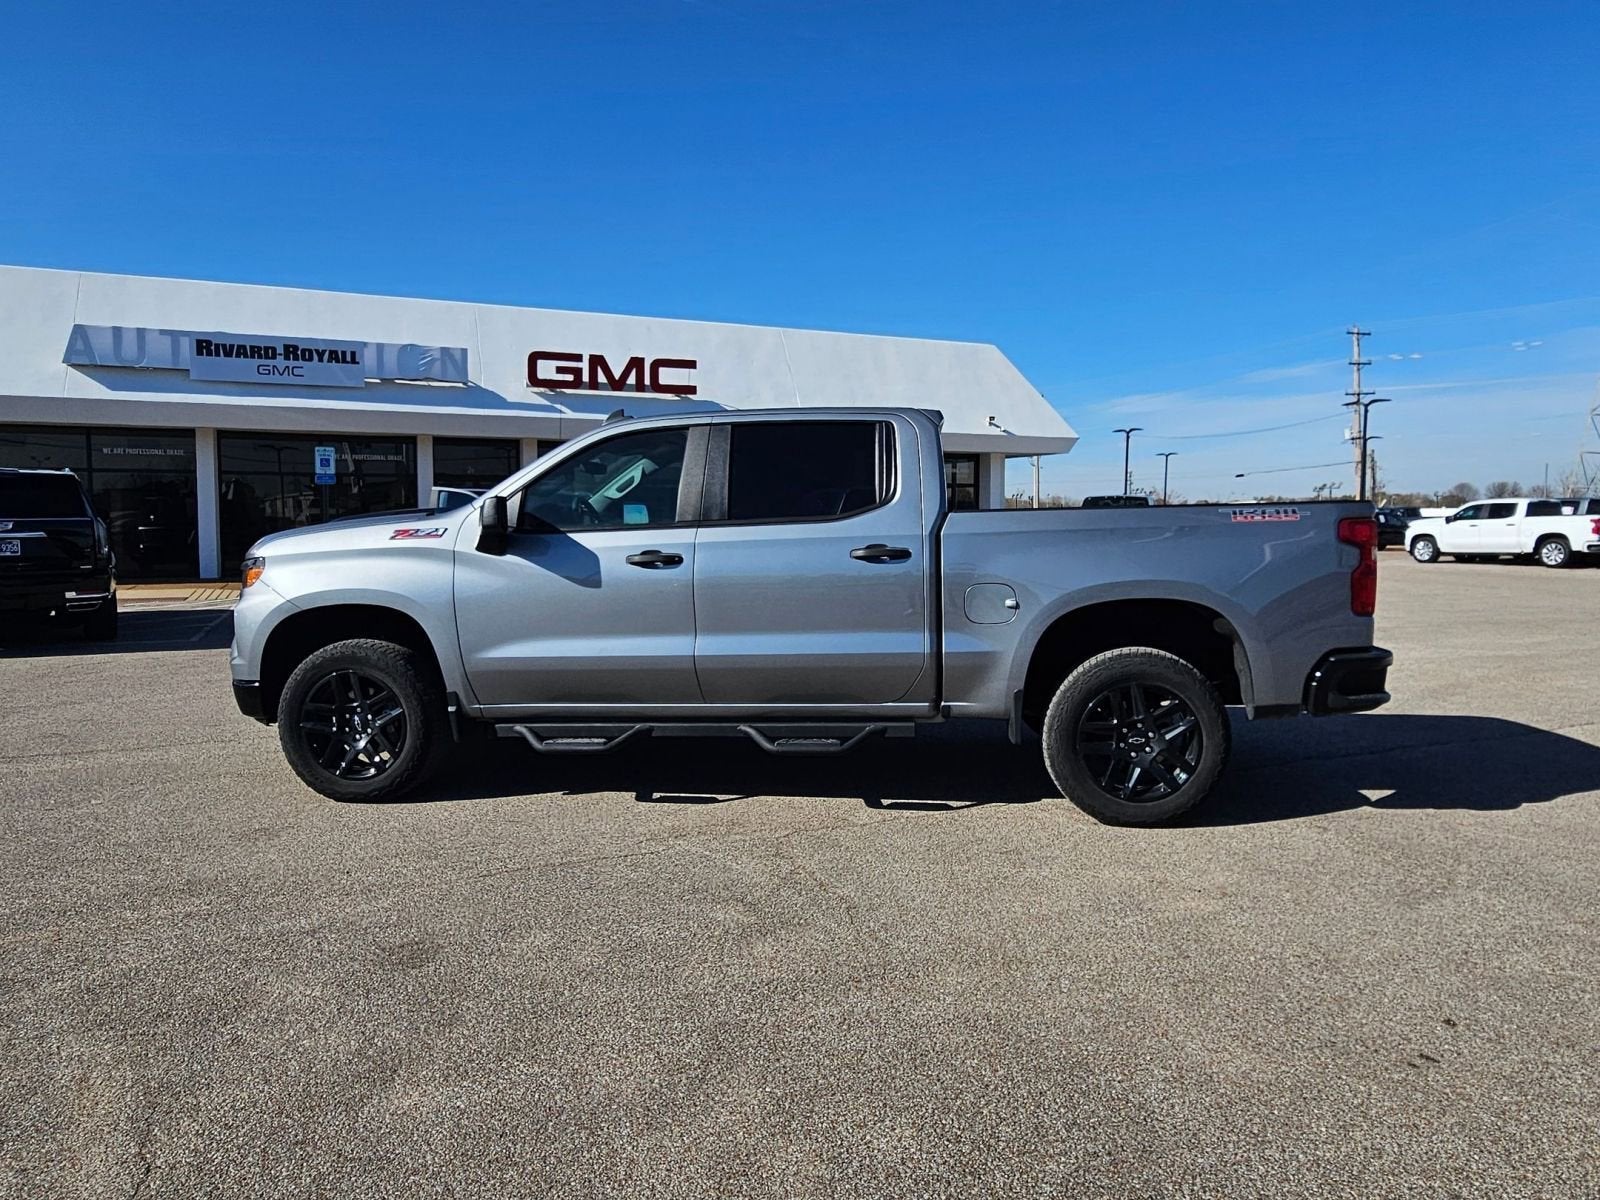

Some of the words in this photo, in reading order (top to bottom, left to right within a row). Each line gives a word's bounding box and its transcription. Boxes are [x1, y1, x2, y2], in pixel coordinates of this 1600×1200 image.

[256, 364, 305, 378] GMC
[527, 350, 697, 395] GMC
[389, 527, 449, 540] Z71
